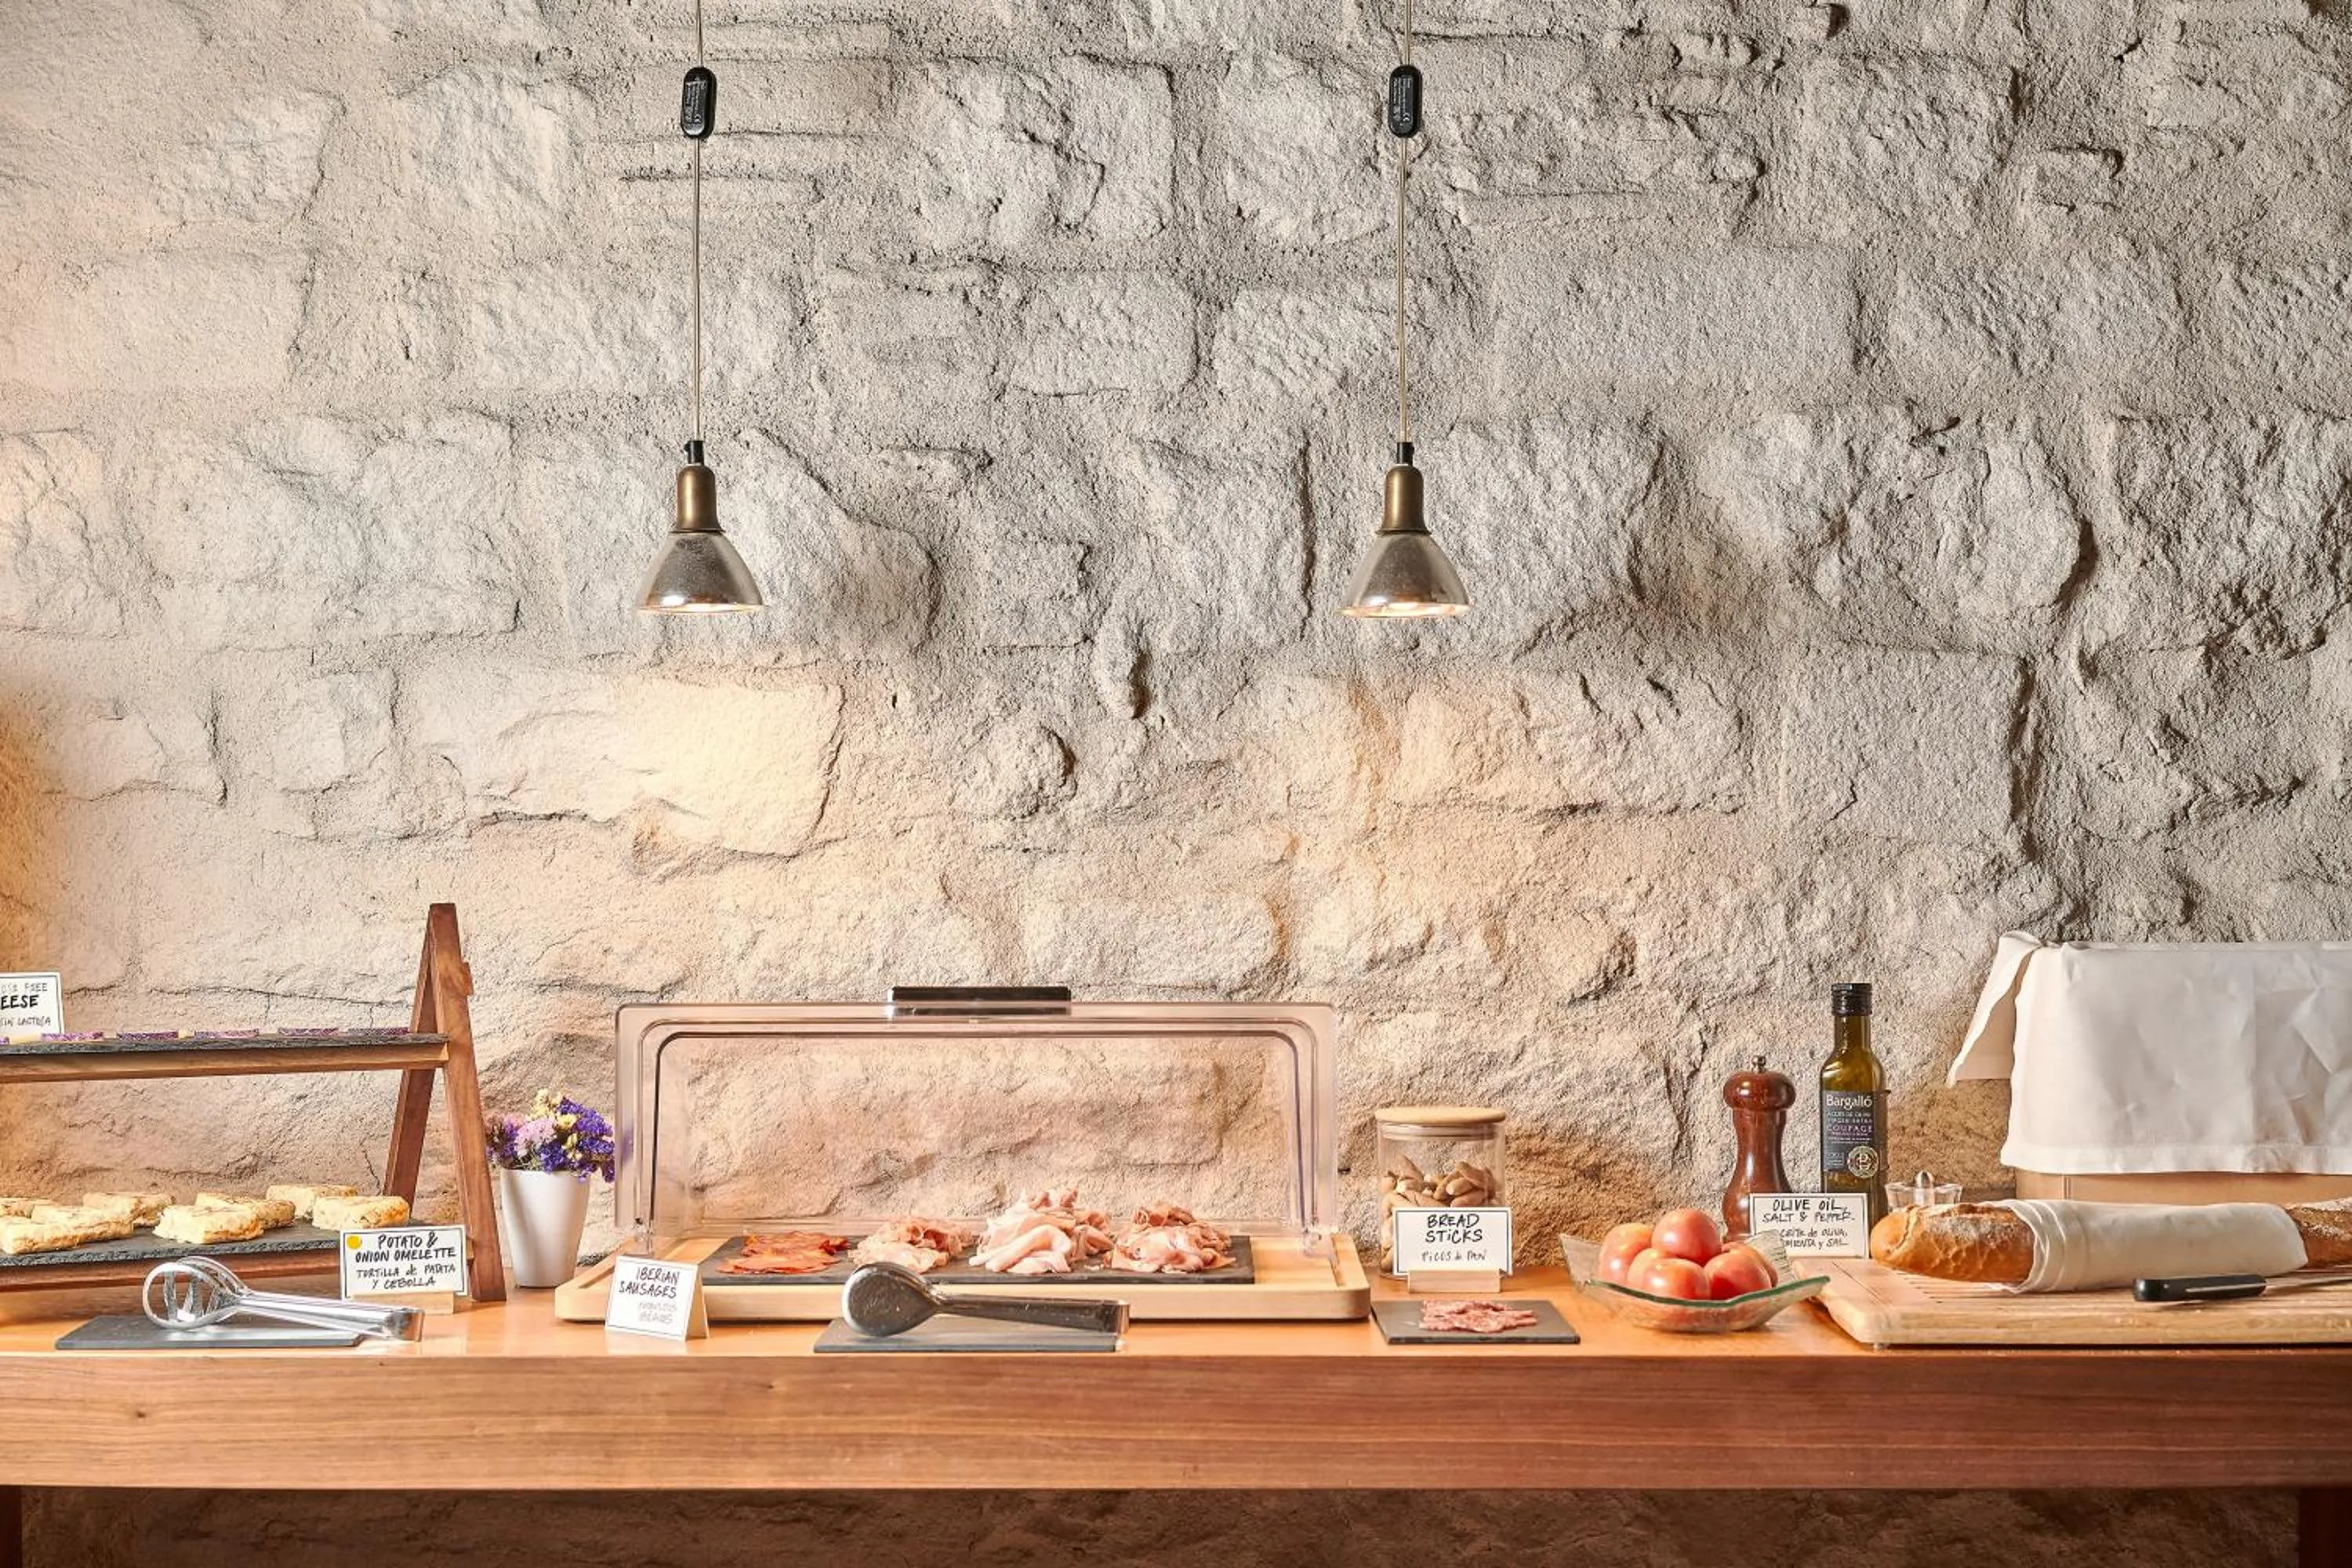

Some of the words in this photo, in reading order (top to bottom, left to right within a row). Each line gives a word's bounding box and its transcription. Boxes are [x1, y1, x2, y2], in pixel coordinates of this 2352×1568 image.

[0, 995, 39, 1010] EESE
[1827, 1094, 1873, 1110] Bargalló
[1773, 1199, 1810, 1212] OLIVE
[1427, 1213, 1480, 1229] BREAD
[1762, 1212, 1795, 1223] SALT
[1799, 1211, 1808, 1222] &
[378, 1233, 423, 1250] POTATO
[426, 1231, 438, 1248] &
[355, 1250, 390, 1263] ONION
[394, 1247, 457, 1261] OMELETTE
[383, 1276, 437, 1290] CEBOLLA
[619, 1280, 677, 1299] SAUSAGES
